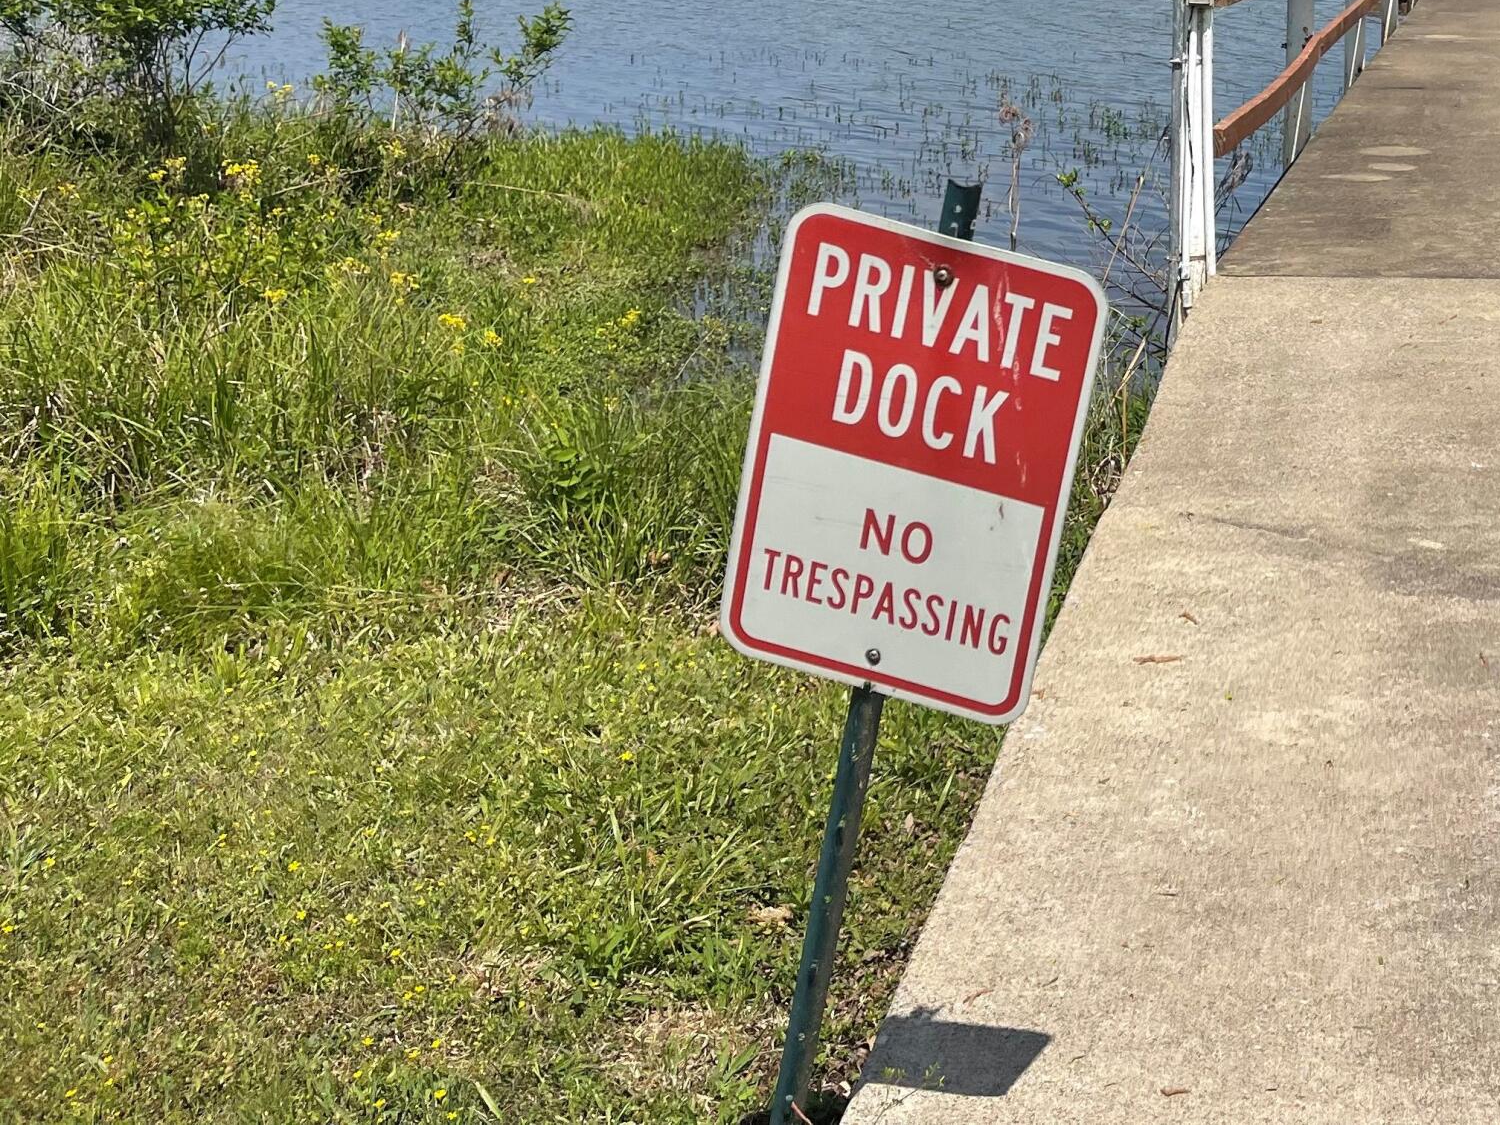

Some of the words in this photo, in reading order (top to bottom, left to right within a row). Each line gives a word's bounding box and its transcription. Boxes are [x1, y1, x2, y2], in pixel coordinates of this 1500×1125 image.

[807, 242, 1073, 381] PRIVATE
[832, 350, 1010, 464] DOCK
[859, 508, 933, 564] NO
[763, 548, 1011, 655] TRESPASSING
